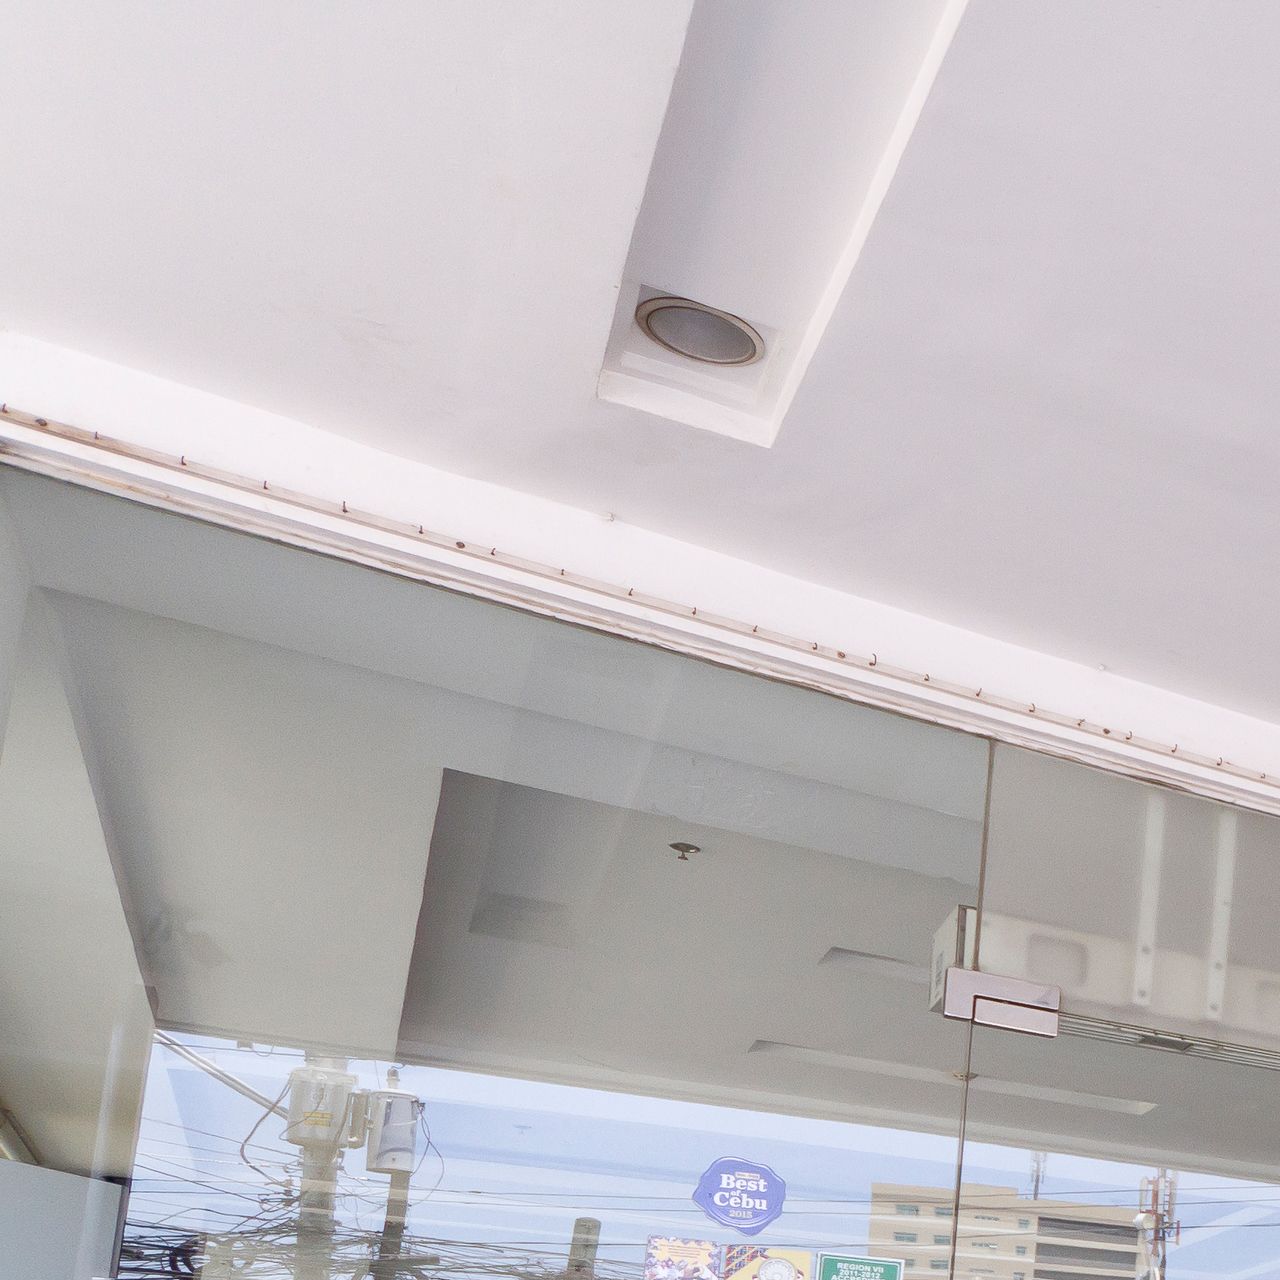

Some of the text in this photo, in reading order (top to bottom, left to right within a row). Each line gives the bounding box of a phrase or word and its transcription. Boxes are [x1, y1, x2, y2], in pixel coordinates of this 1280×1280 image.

[720, 1173, 768, 1193] Best
[713, 1192, 768, 1211] Cebu
[837, 1262, 871, 1272] REGION
